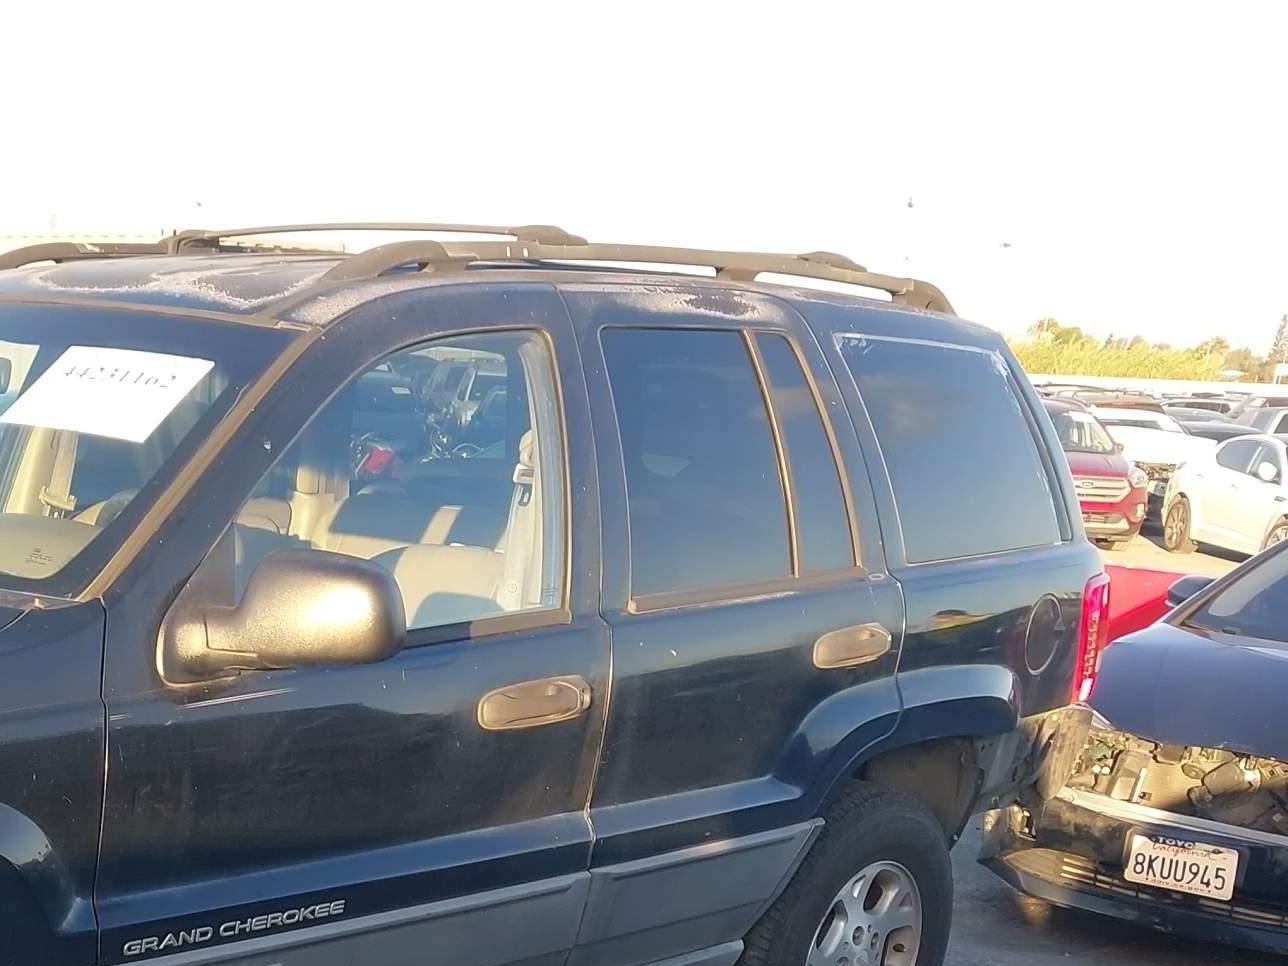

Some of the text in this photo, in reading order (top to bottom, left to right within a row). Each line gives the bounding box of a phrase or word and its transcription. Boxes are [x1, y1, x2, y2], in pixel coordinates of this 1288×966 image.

[1132, 852, 1227, 892] 8KUU945
[122, 898, 347, 957] GRAND CHEROKEE
